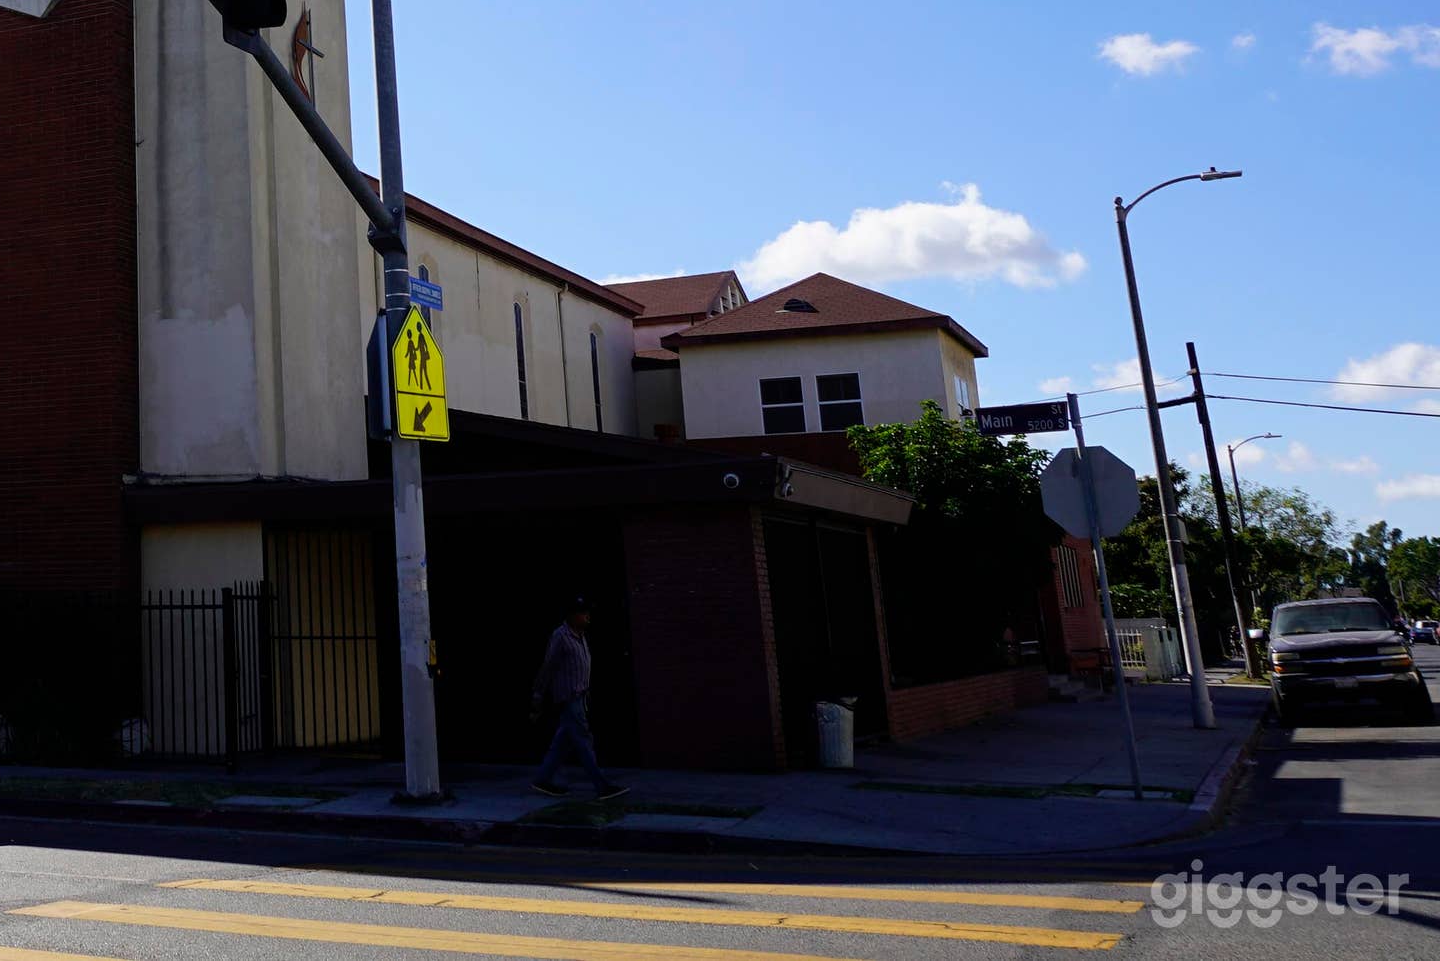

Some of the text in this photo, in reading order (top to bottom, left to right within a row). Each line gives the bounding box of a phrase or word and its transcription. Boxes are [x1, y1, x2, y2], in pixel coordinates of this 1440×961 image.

[1051, 405, 1062, 415] St
[980, 414, 1013, 429] Main
[1027, 418, 1065, 431] 5200 S
